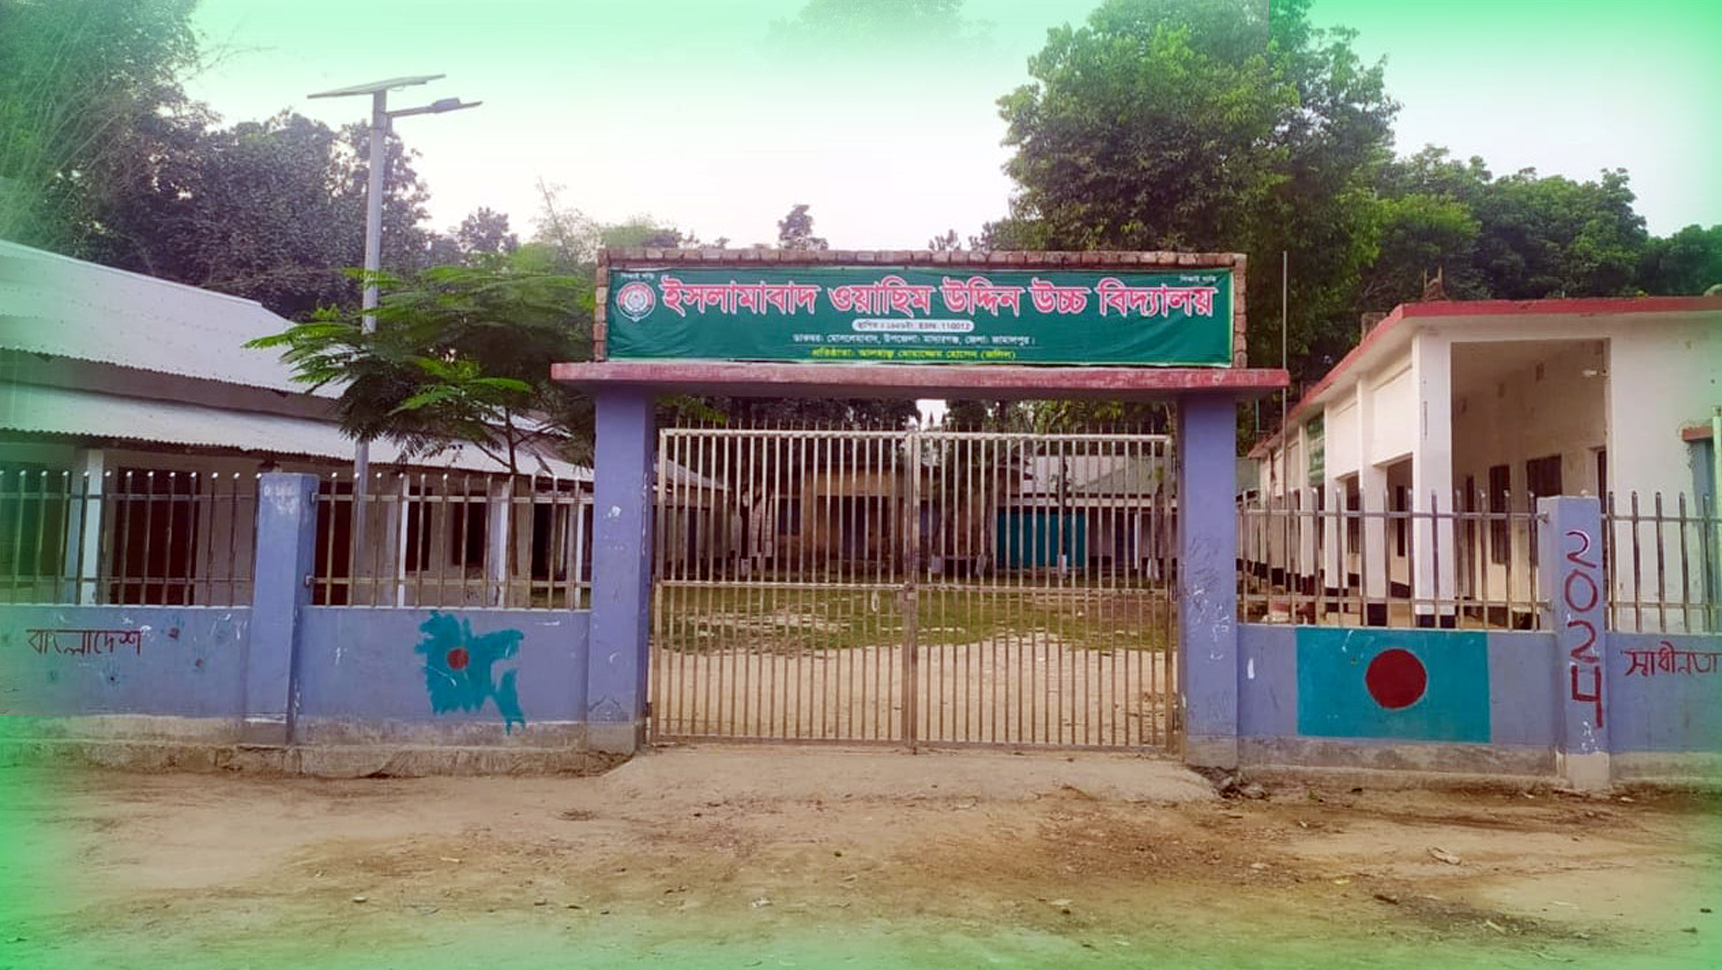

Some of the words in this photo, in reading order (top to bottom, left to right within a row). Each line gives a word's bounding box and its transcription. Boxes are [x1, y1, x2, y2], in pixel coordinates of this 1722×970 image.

[659, 275, 821, 317] ইসলামাবাদ
[828, 275, 936, 317] ওয়াছিম
[939, 276, 1026, 317] উদ্দিন
[1030, 277, 1092, 315] উচ্চ
[1095, 277, 1219, 318] বিদ্যালয়
[26, 629, 143, 656] বাংলাদেশ
[1564, 530, 1603, 729] 2024
